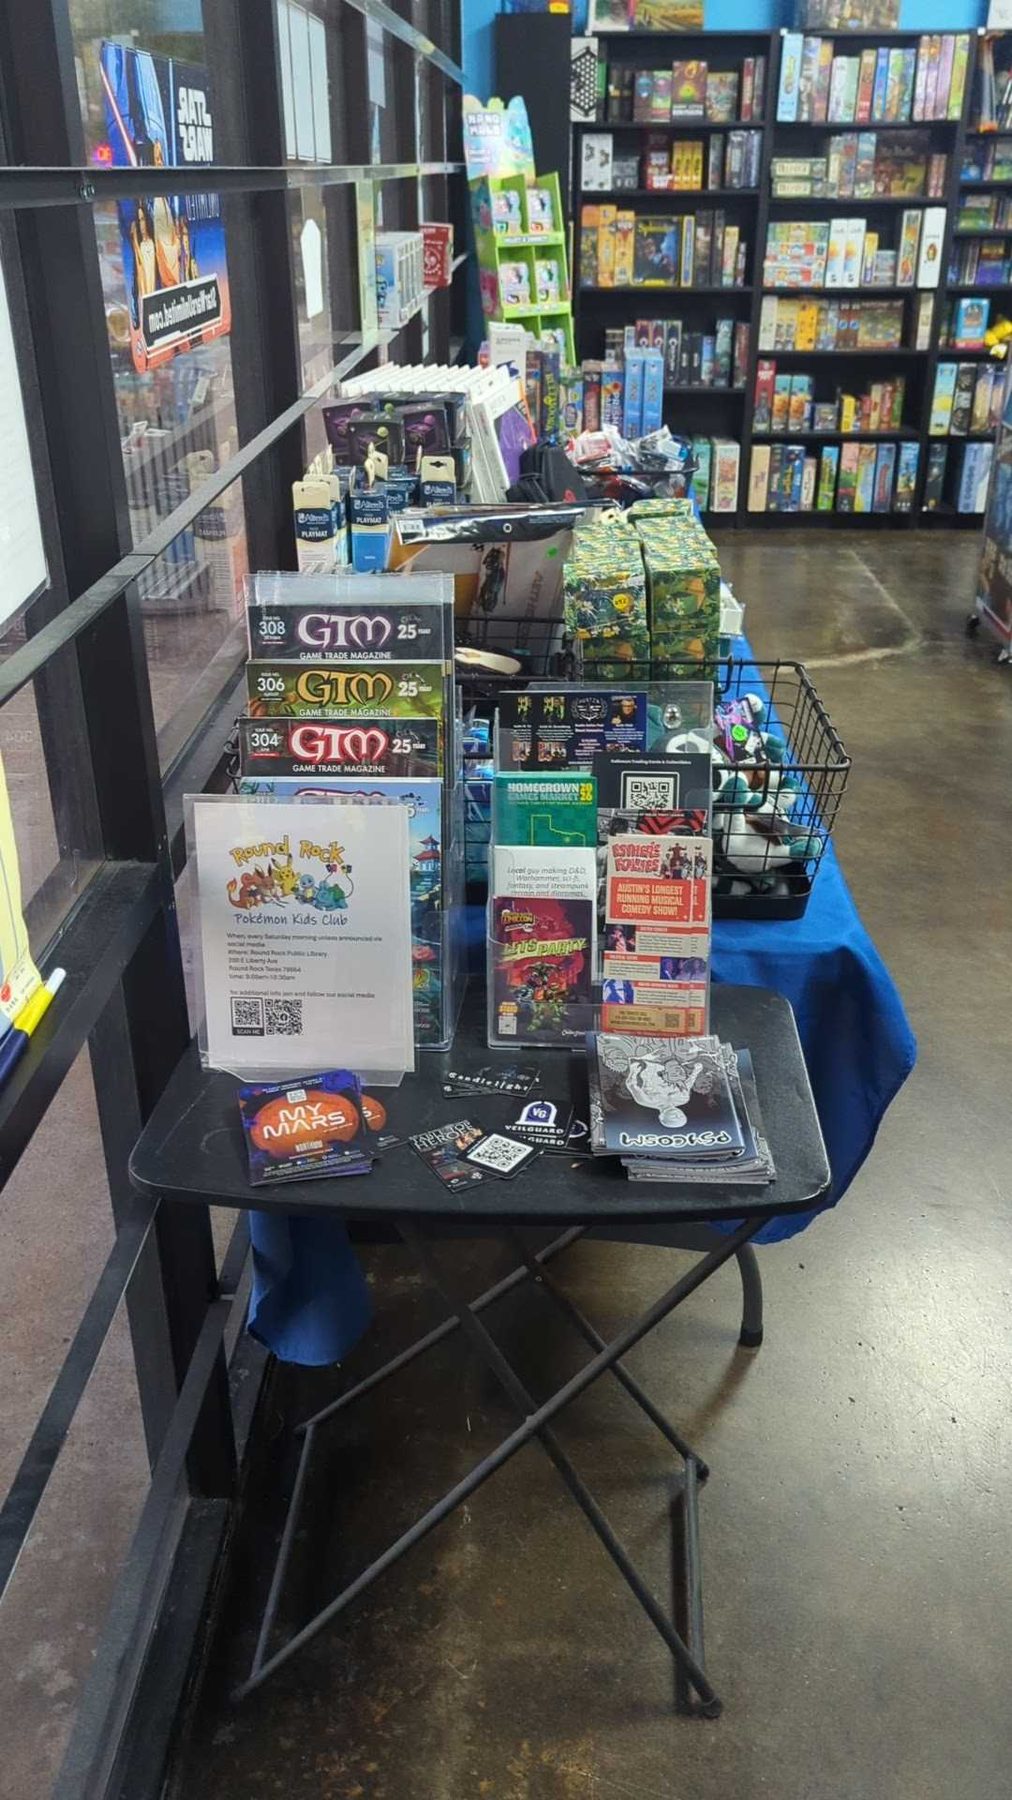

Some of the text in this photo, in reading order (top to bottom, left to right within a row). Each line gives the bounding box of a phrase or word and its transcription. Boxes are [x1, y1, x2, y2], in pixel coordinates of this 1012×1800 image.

[301, 530, 328, 538] PLAYMAT
[259, 621, 286, 635] 308
[298, 614, 391, 648] GTM
[397, 624, 417, 639] 25
[257, 677, 286, 691] 306
[297, 671, 392, 706] GTM
[398, 682, 418, 697] 25
[300, 708, 391, 716] GAME TRADE MAGAZINE
[251, 733, 279, 747] 304
[291, 726, 386, 761] GTM
[392, 739, 411, 753] 25
[344, 765, 386, 773] MAGAZINE
[508, 783, 579, 793] HOMEGROWN
[229, 834, 346, 867] Round Rock
[612, 841, 660, 858] ESTHER'S
[541, 867, 567, 875] making
[615, 858, 660, 872] FOLLIES
[617, 884, 684, 895] AUSTIN'S LONGEST
[617, 894, 684, 905] RUNNING MUSICAL
[621, 905, 679, 916] COMEDY SHOW!
[233, 913, 348, 926] Pokémon Kids Club
[264, 933, 291, 941] Saturday
[448, 1071, 530, 1092] Candlelight
[279, 1102, 323, 1123] MY
[532, 1107, 547, 1119] VG
[263, 1111, 346, 1139] MARS
[504, 1124, 564, 1135] VEILGUARD
[619, 1130, 732, 1148] PSYCOSM
